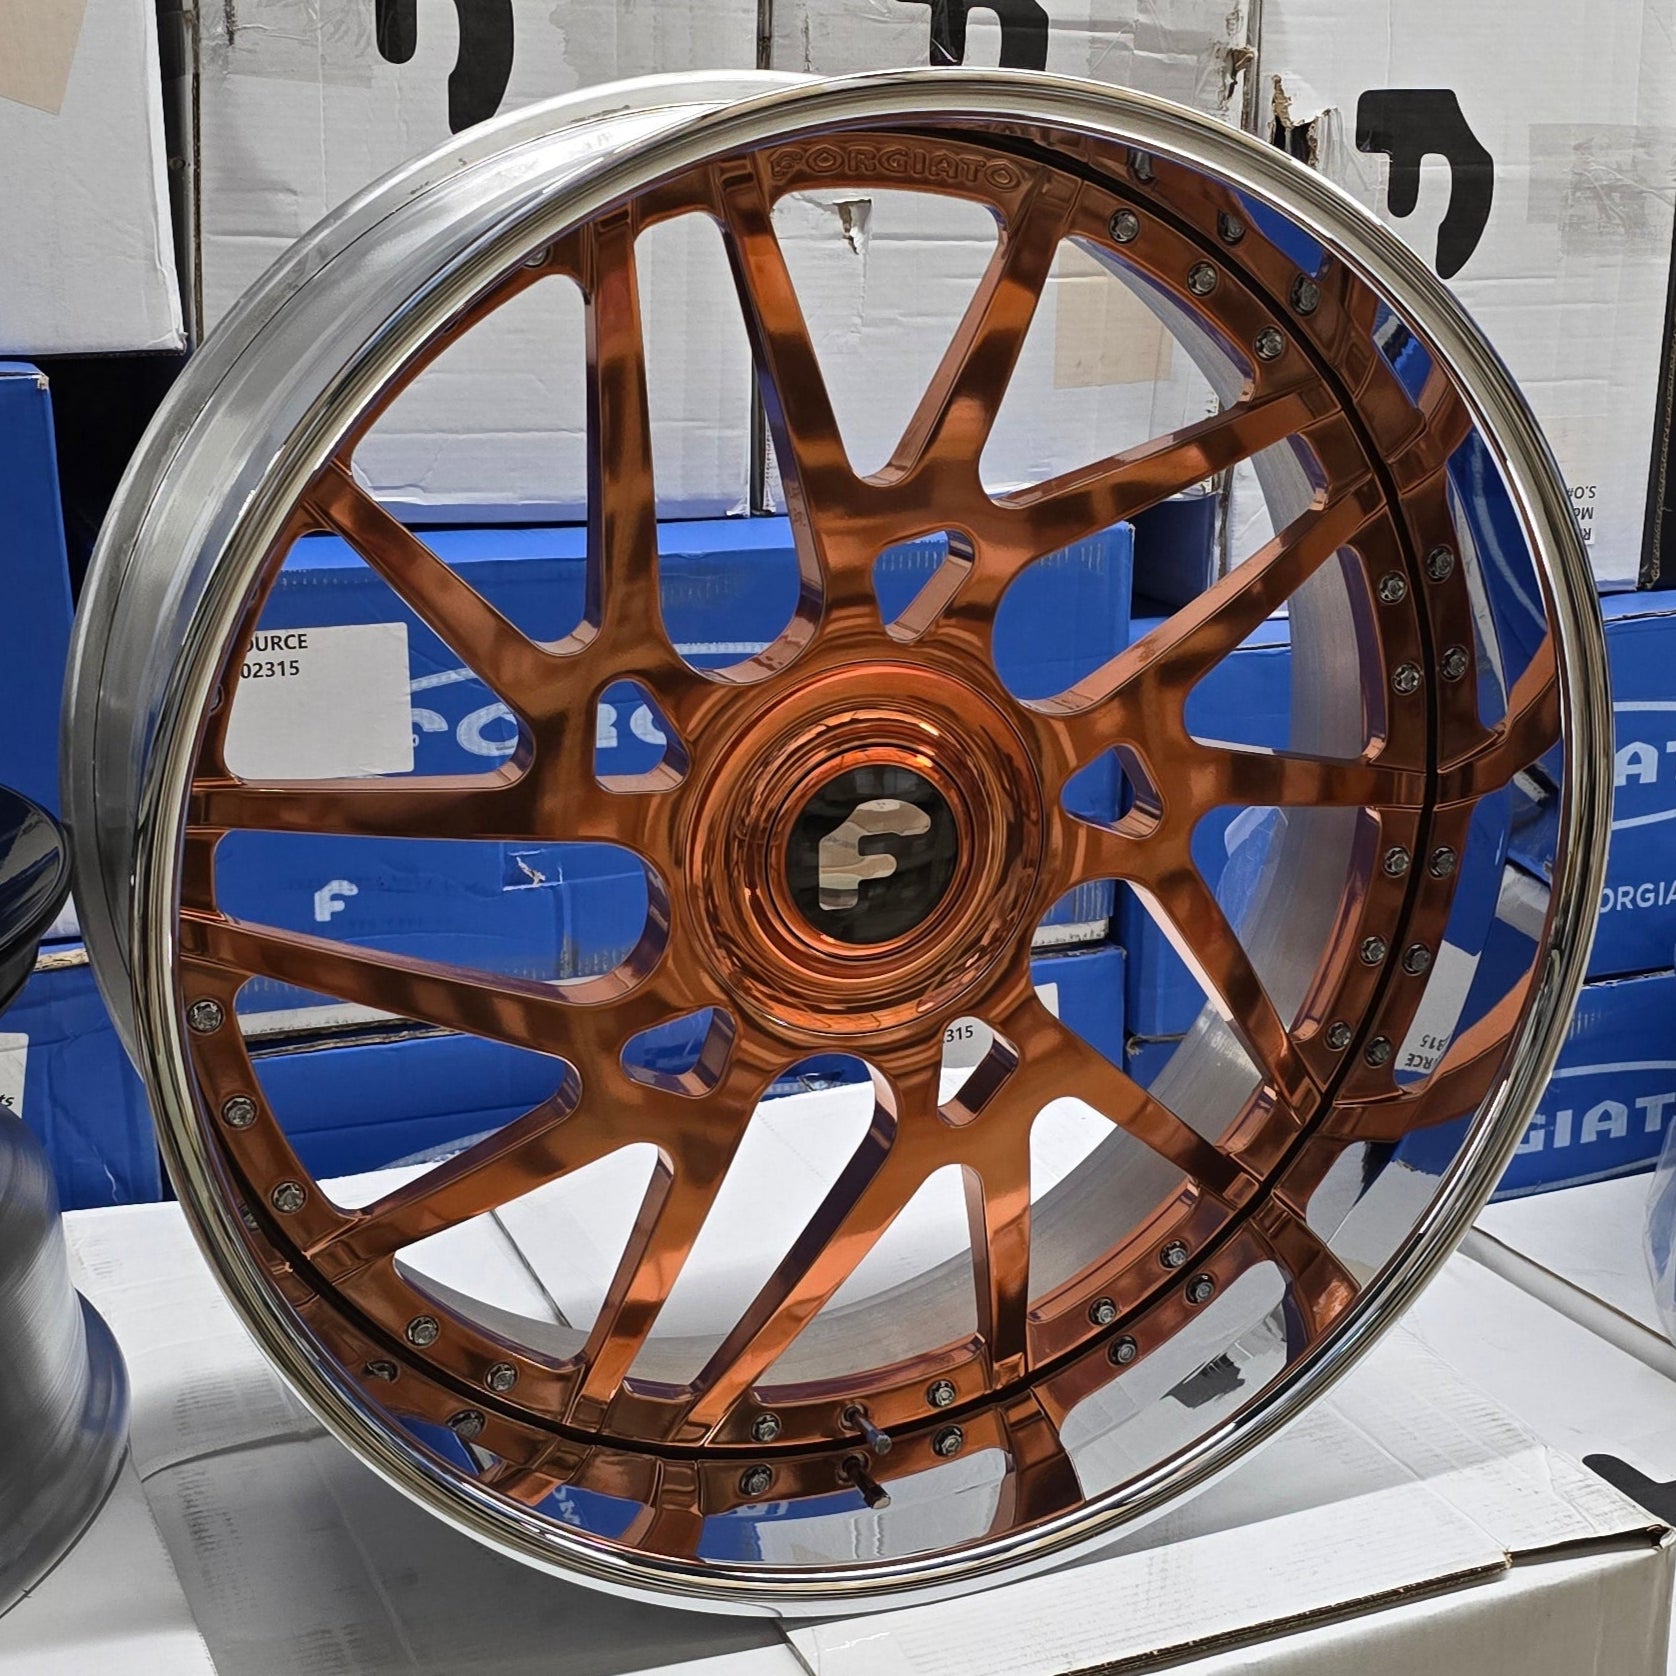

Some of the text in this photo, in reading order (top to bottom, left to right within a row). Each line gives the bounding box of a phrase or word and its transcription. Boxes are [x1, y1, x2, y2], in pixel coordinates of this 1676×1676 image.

[769, 145, 1023, 192] FORGIATO
[240, 660, 300, 679] 02315
[819, 799, 931, 911] F
[314, 879, 359, 922] F
[943, 1024, 974, 1043] 315
[1404, 1053, 1438, 1069] RCE
